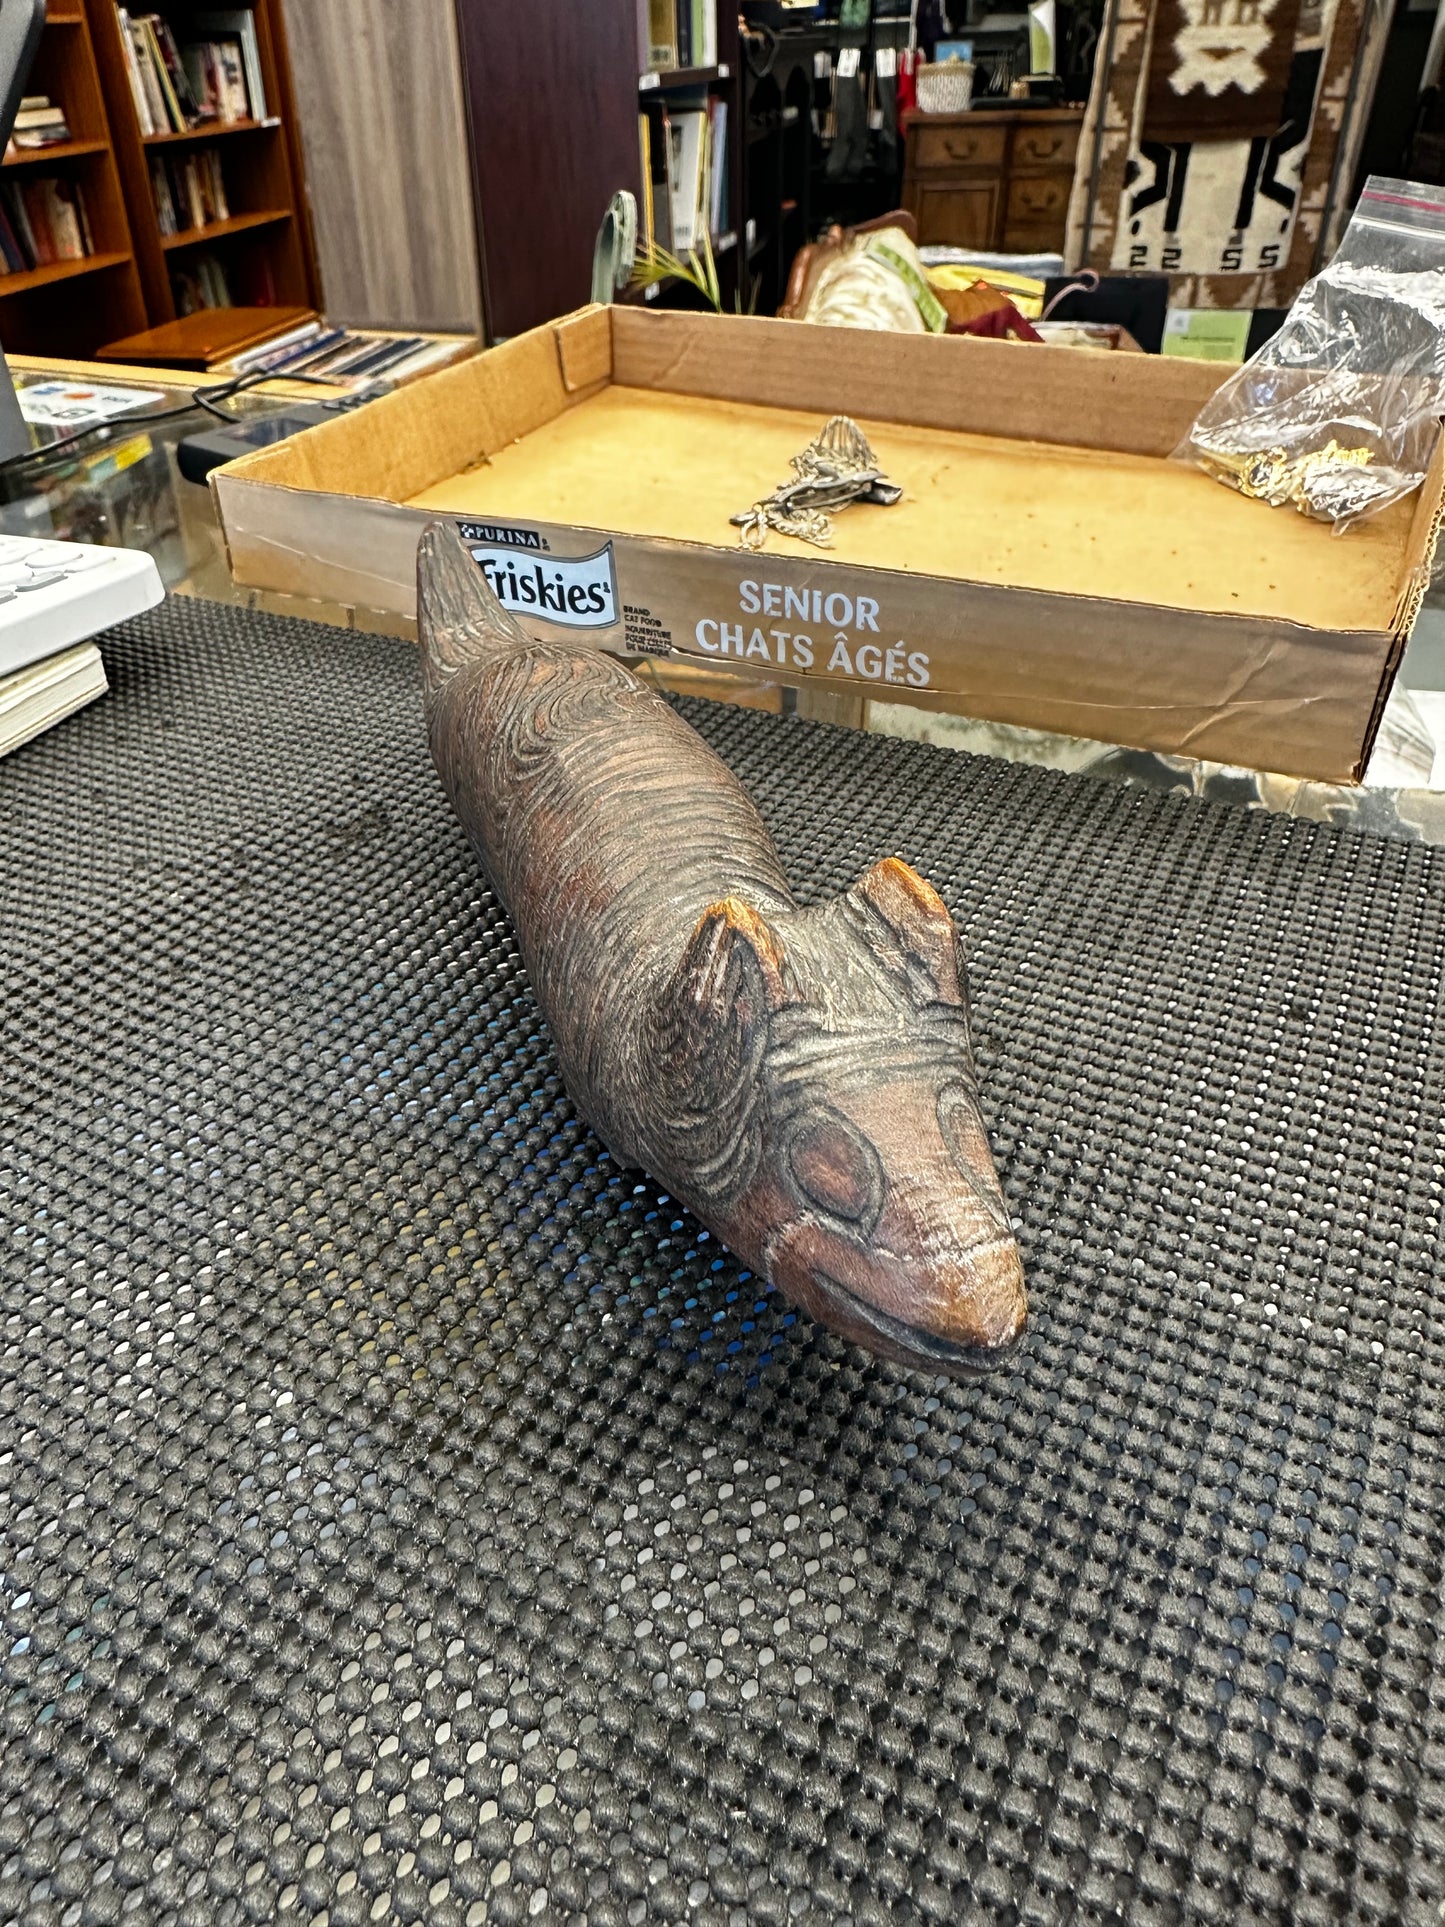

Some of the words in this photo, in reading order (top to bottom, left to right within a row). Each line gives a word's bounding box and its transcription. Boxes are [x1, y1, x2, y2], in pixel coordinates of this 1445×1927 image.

[476, 526, 538, 547] PURINA
[640, 616, 662, 627] FOOD
[738, 578, 880, 633] SENIOR
[695, 618, 815, 668] CHATS
[826, 631, 931, 687] ÂGÉS
